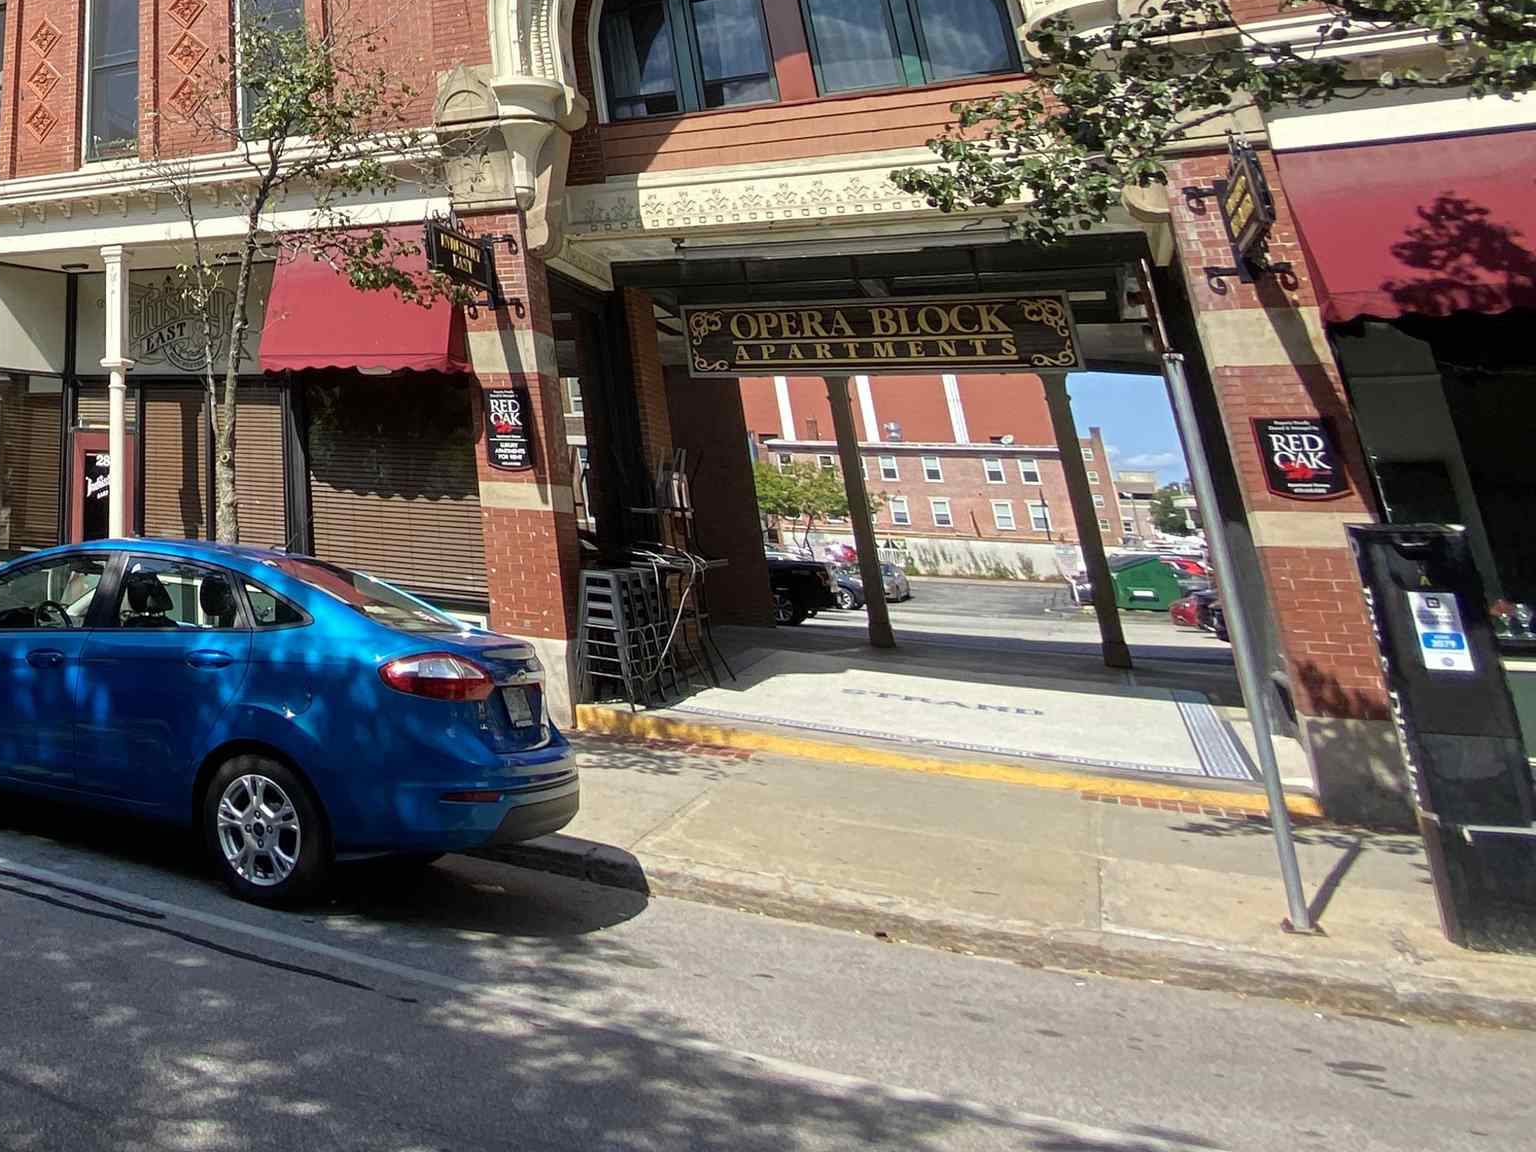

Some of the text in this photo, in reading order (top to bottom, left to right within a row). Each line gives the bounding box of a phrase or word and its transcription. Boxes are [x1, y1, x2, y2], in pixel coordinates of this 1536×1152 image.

[729, 304, 1013, 340] OPERA BLOCK
[145, 321, 186, 352] EAST
[735, 337, 1018, 361] APARTMENTS
[489, 399, 520, 414] RED
[489, 412, 523, 426] OAK
[1267, 434, 1325, 453] RED
[1273, 451, 1333, 469] OAK
[841, 688, 1044, 716] STRAND
